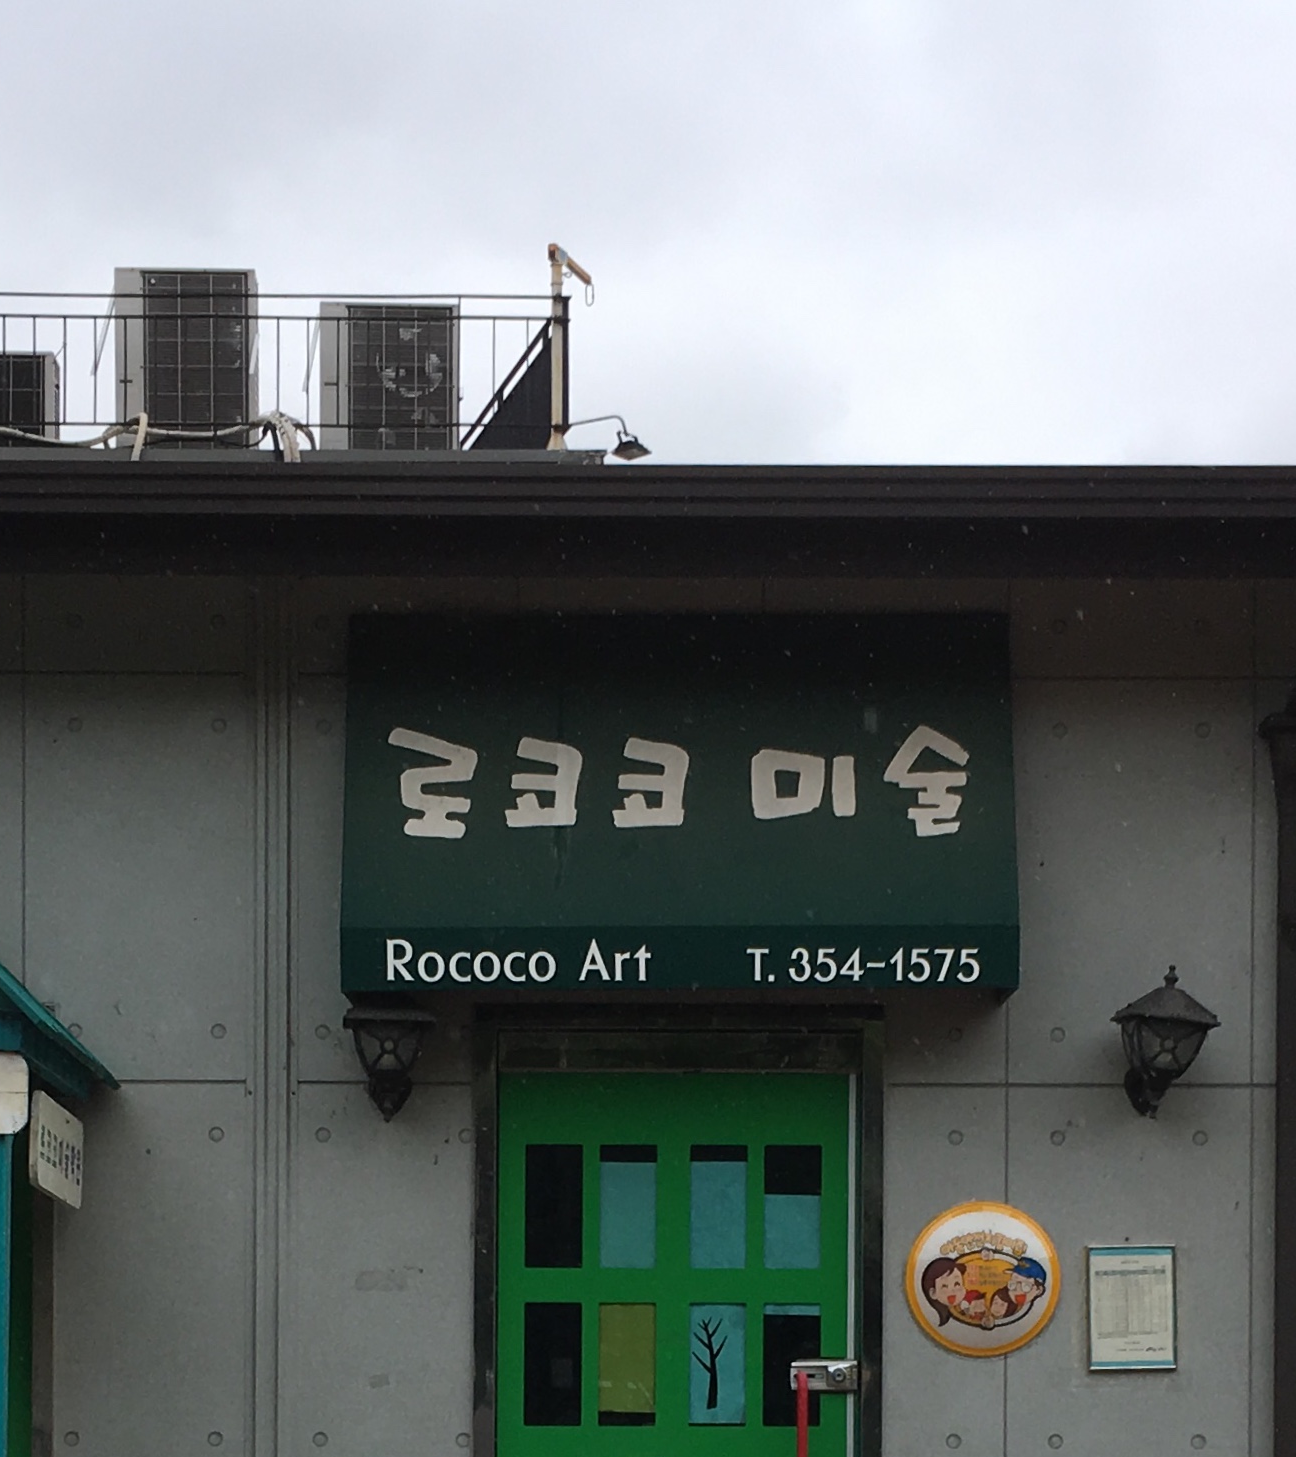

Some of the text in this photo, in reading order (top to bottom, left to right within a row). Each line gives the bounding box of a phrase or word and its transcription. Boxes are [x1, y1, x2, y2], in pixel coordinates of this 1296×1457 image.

[387, 725, 970, 839] 로코코 미술
[386, 938, 652, 983] Rococo Art
[746, 947, 980, 983] T. 354-1575
